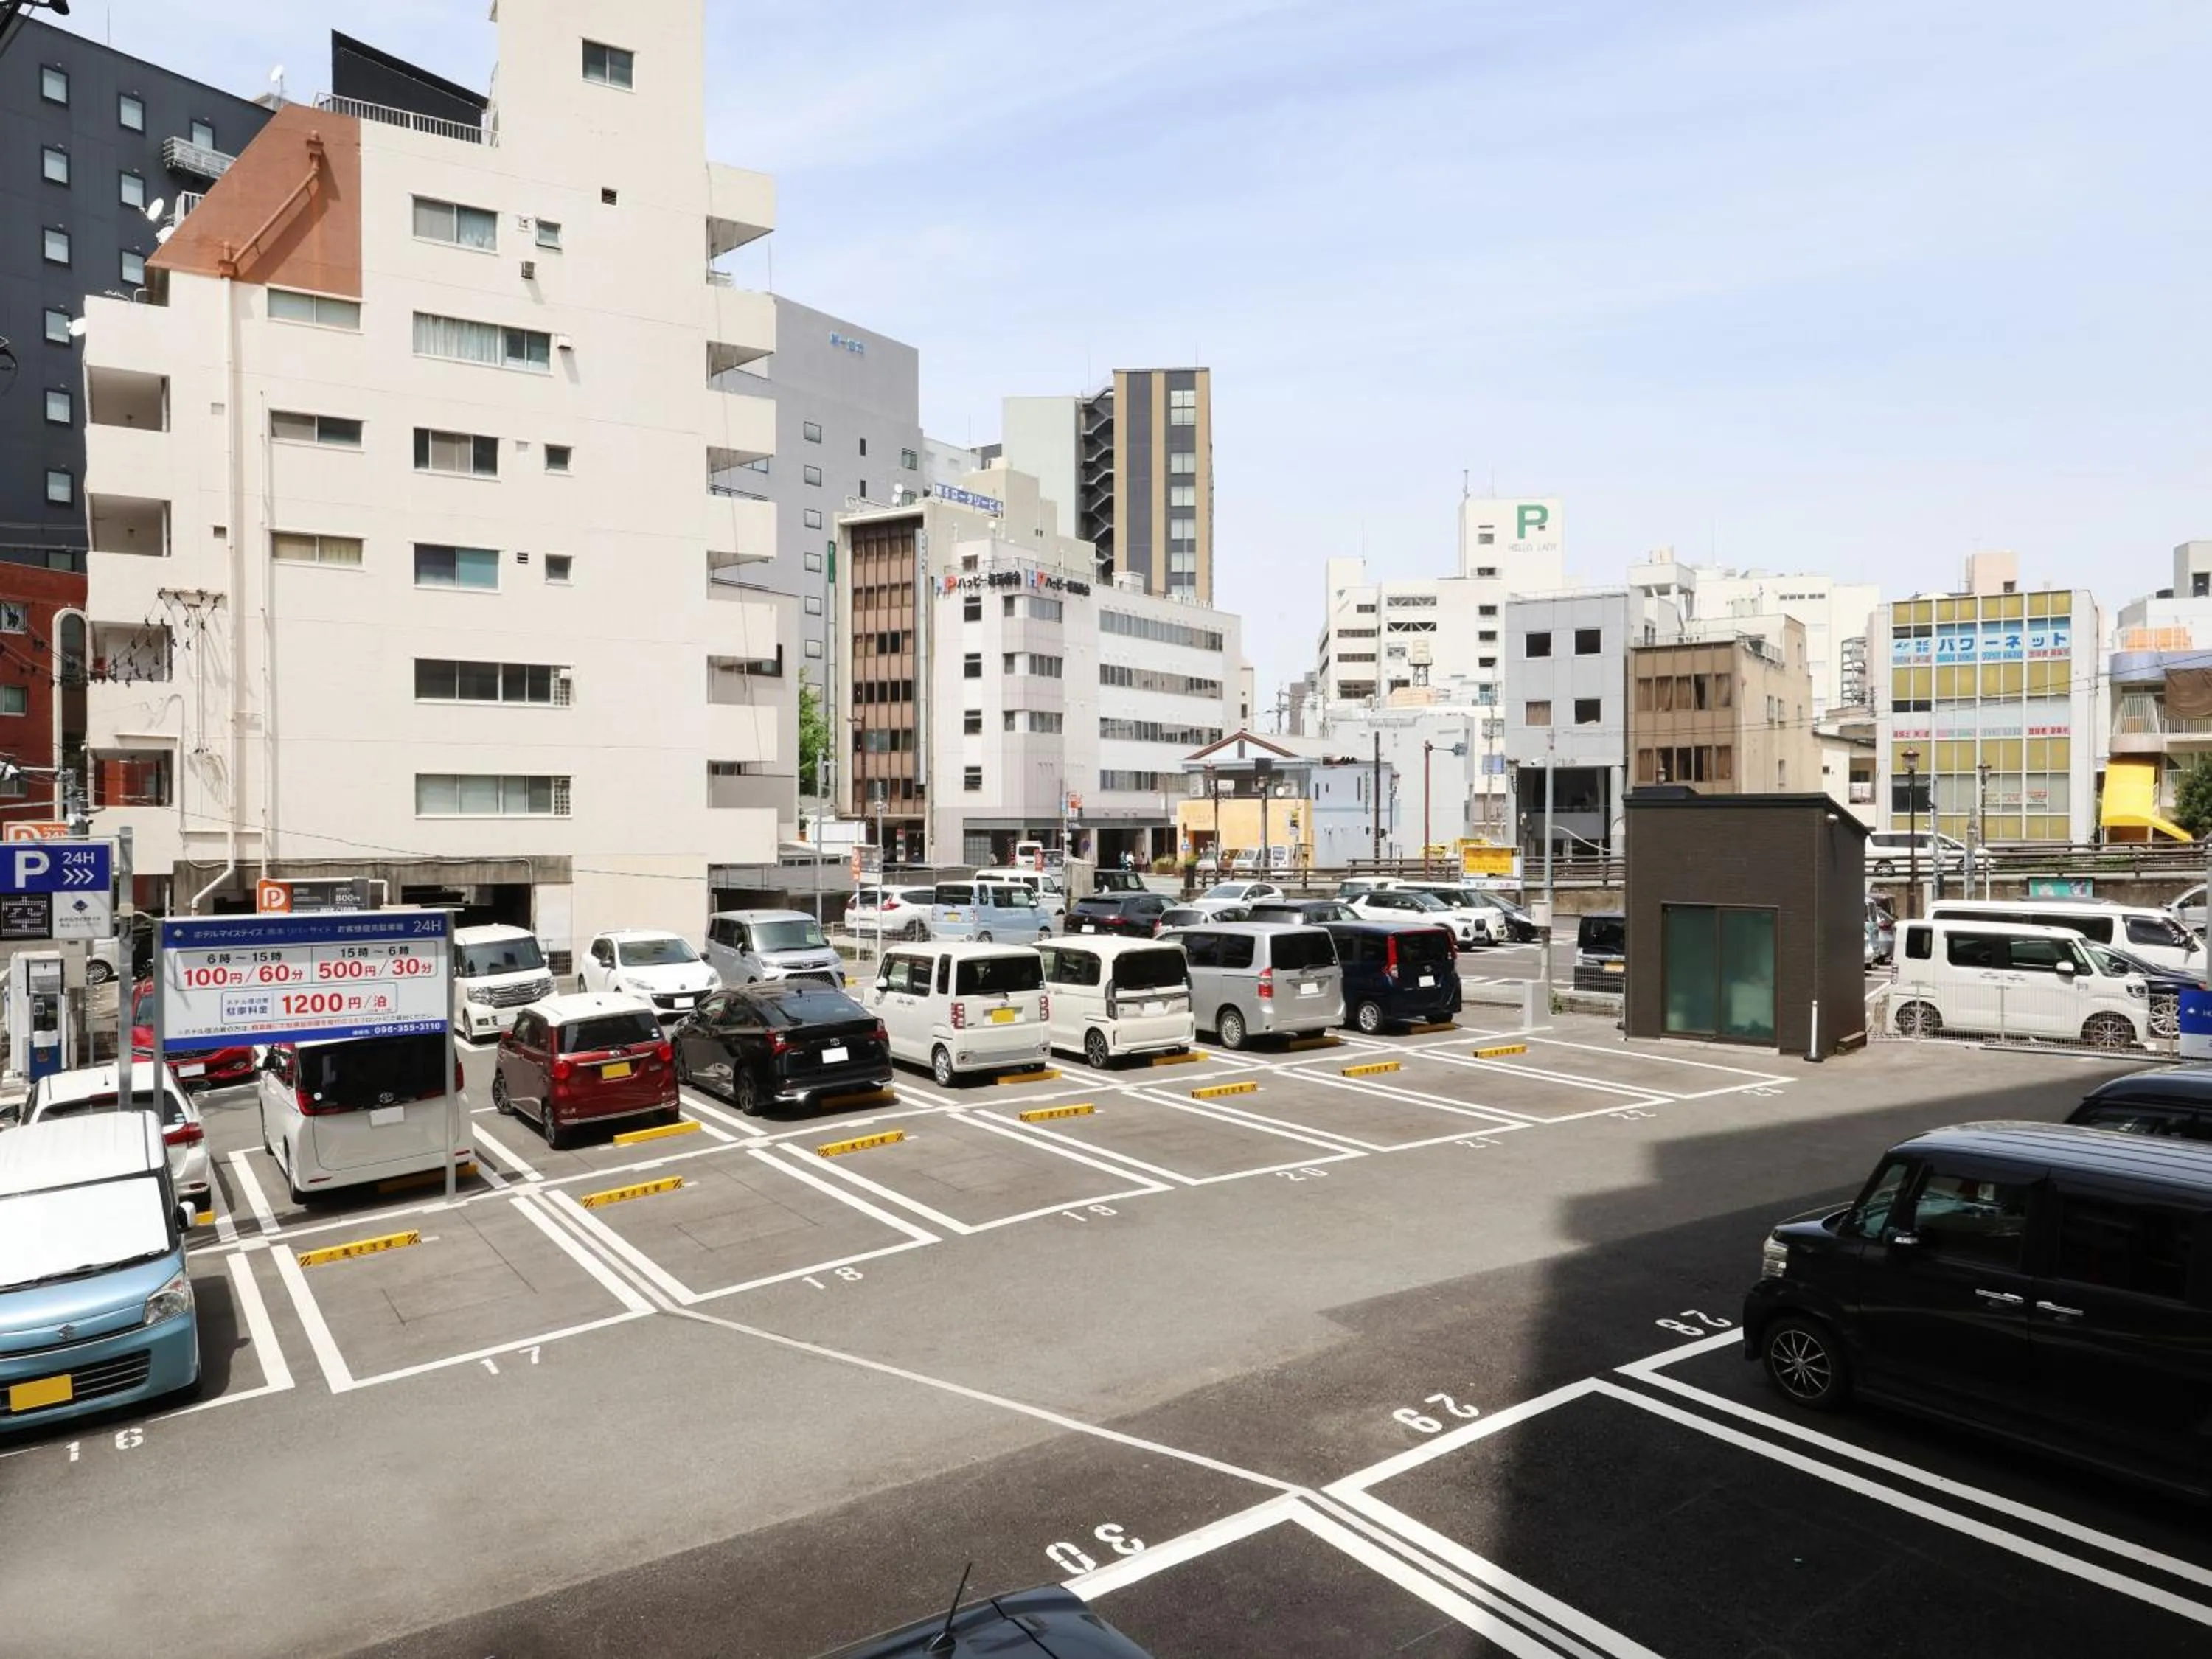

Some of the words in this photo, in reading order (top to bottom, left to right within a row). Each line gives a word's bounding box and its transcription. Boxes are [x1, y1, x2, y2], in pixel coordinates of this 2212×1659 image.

[1517, 505, 1548, 539] P
[1938, 632, 2067, 652] パワーネット
[14, 850, 50, 888] P
[62, 852, 95, 865] 24H
[413, 919, 442, 933] 24H
[184, 964, 304, 987] 100円/60分
[319, 958, 433, 980] 500円/30分
[1608, 1110, 1657, 1120] 22
[1276, 1167, 1329, 1181] 20
[802, 1266, 863, 1290] 18
[1655, 1309, 1733, 1335] 28
[480, 1345, 540, 1374] 17
[1392, 1393, 1479, 1433] 29
[65, 1428, 144, 1462] 16
[1046, 1523, 1145, 1574] 30
